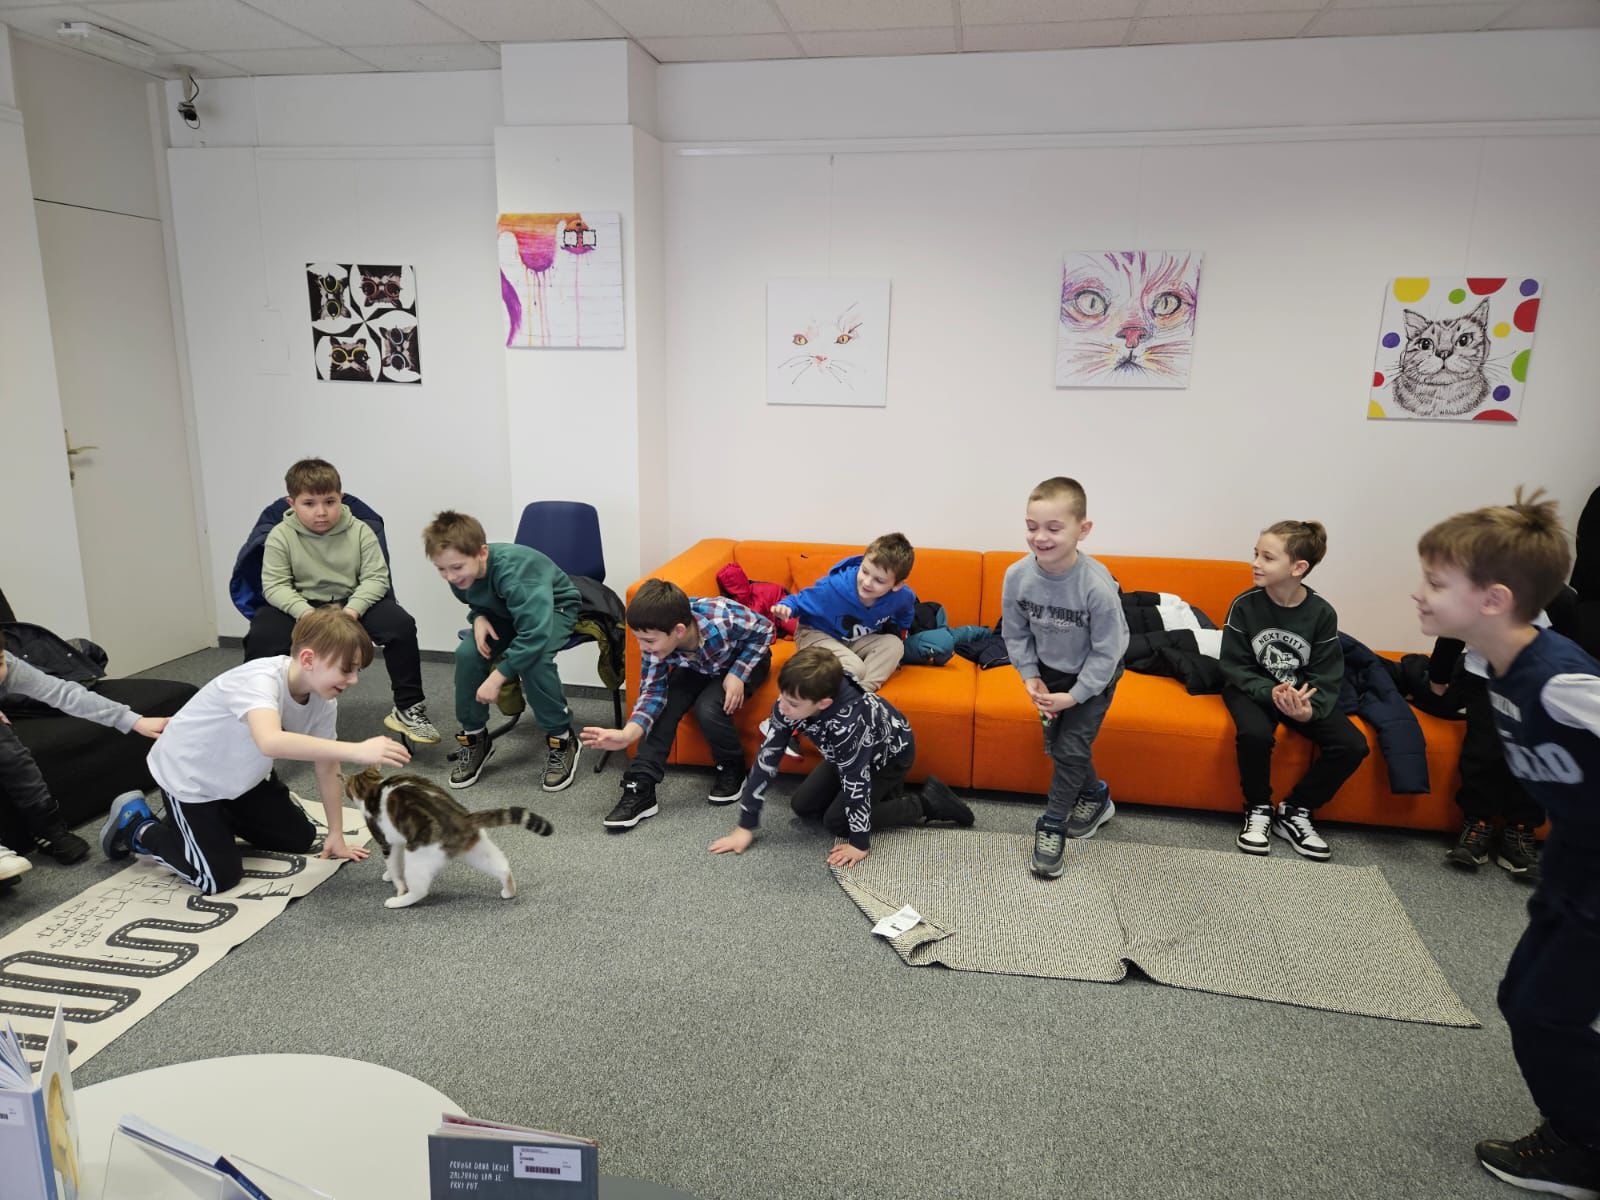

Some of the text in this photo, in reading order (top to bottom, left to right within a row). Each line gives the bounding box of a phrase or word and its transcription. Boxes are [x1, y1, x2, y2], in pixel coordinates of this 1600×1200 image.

[1047, 605, 1084, 627] YORK
[1258, 632, 1304, 650] NEXT CITY
